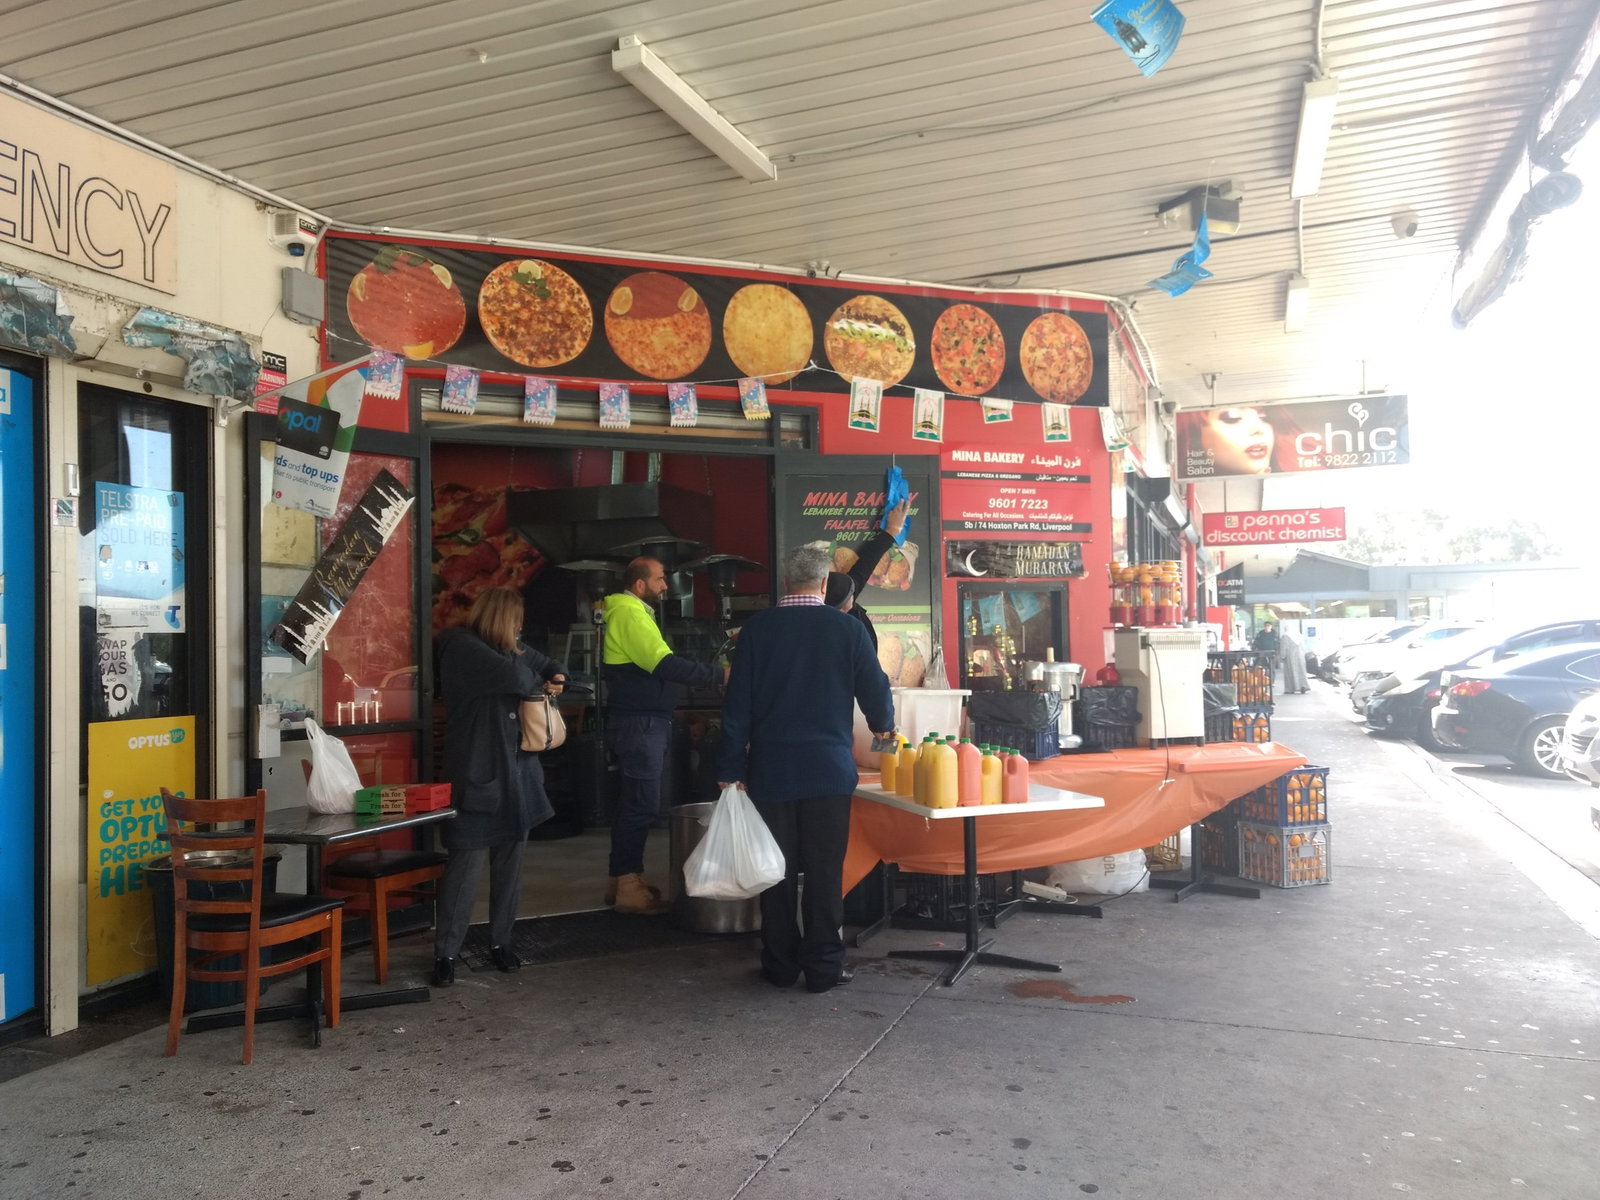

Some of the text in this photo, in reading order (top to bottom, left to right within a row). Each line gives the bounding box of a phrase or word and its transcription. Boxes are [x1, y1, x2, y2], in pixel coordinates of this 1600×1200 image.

[1295, 404, 1398, 456] chic
[951, 450, 1025, 464] MINA BAKERY
[1062, 456, 1082, 469] فرن
[1187, 449, 1204, 461] Hair
[1296, 453, 1397, 469] Tel: 9822 2112
[1187, 457, 1215, 470] Beauty
[1187, 465, 1214, 476] Salon
[287, 462, 302, 472] and
[301, 463, 319, 479] top
[319, 470, 340, 484] ups
[99, 489, 161, 511] TELSTRA
[802, 491, 919, 507] MINA BAKY
[988, 498, 1049, 510] 9601 7223
[101, 508, 168, 530] PRE-PAID
[802, 507, 846, 516] LEBANESE
[845, 507, 869, 516] PIZZA
[962, 511, 983, 520] Catering
[824, 519, 869, 530] FALAFEL
[964, 521, 974, 529] 5b
[978, 521, 987, 529] 74
[988, 521, 1012, 530] Hoxton
[1013, 522, 1029, 530] Park
[1041, 523, 1073, 532] Liverpool
[1243, 510, 1321, 530] penna's
[101, 527, 137, 545] SOLD
[143, 529, 178, 548] HERE
[836, 531, 861, 541] 9601
[1206, 526, 1342, 544] discount chemist
[1016, 545, 1070, 560] RAMADAN
[1016, 560, 1072, 576] MUBARAK
[98, 639, 127, 650] WAP
[99, 651, 127, 661] OUR
[128, 734, 170, 750] OPTUS
[370, 790, 390, 798] Fresh
[391, 790, 402, 798] for
[100, 799, 135, 819] GET
[370, 802, 390, 810] Fresh
[391, 801, 402, 810] for
[99, 812, 186, 844] OPTU
[99, 839, 173, 867] PREPAI
[100, 861, 144, 899] HE
